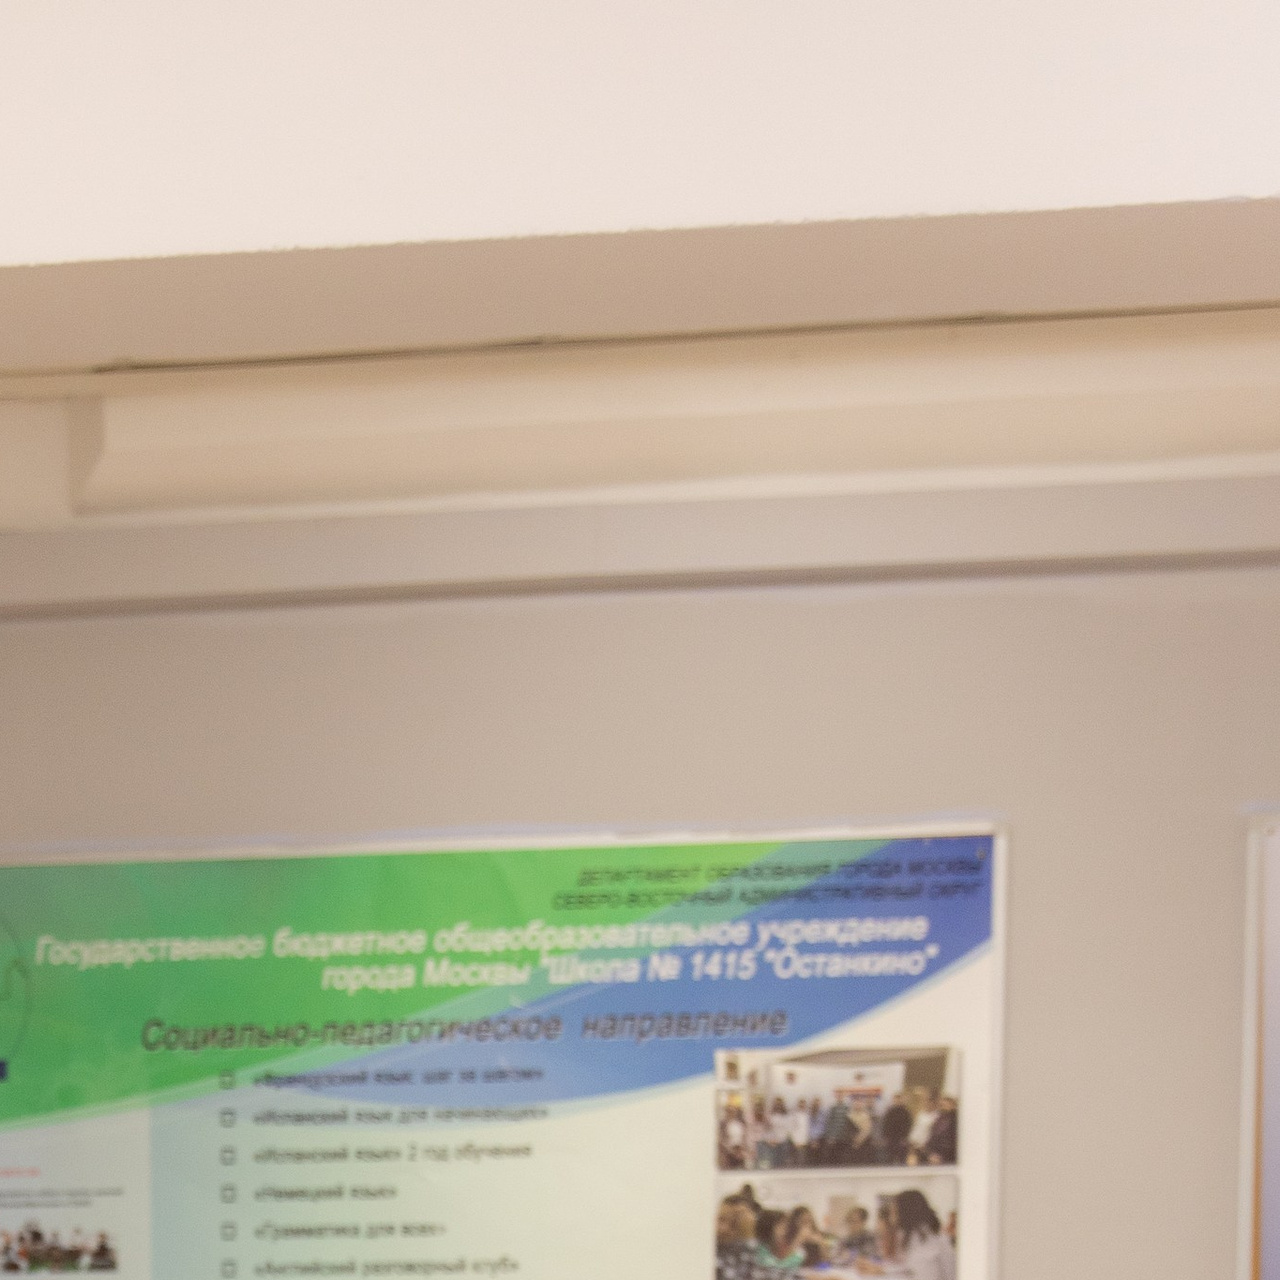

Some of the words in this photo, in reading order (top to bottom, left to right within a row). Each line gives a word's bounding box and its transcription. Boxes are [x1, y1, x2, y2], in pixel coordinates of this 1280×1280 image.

[34, 933, 266, 971] Государственное
[273, 927, 426, 961] бюджетное
[433, 919, 748, 958] общеобразовательное
[755, 914, 930, 952] учреждение
[321, 964, 417, 997] города
[422, 958, 533, 989] Москвы
[690, 950, 757, 981] 1415
[139, 1012, 563, 1054] Социально-педагогическое
[581, 1008, 789, 1045] направление
